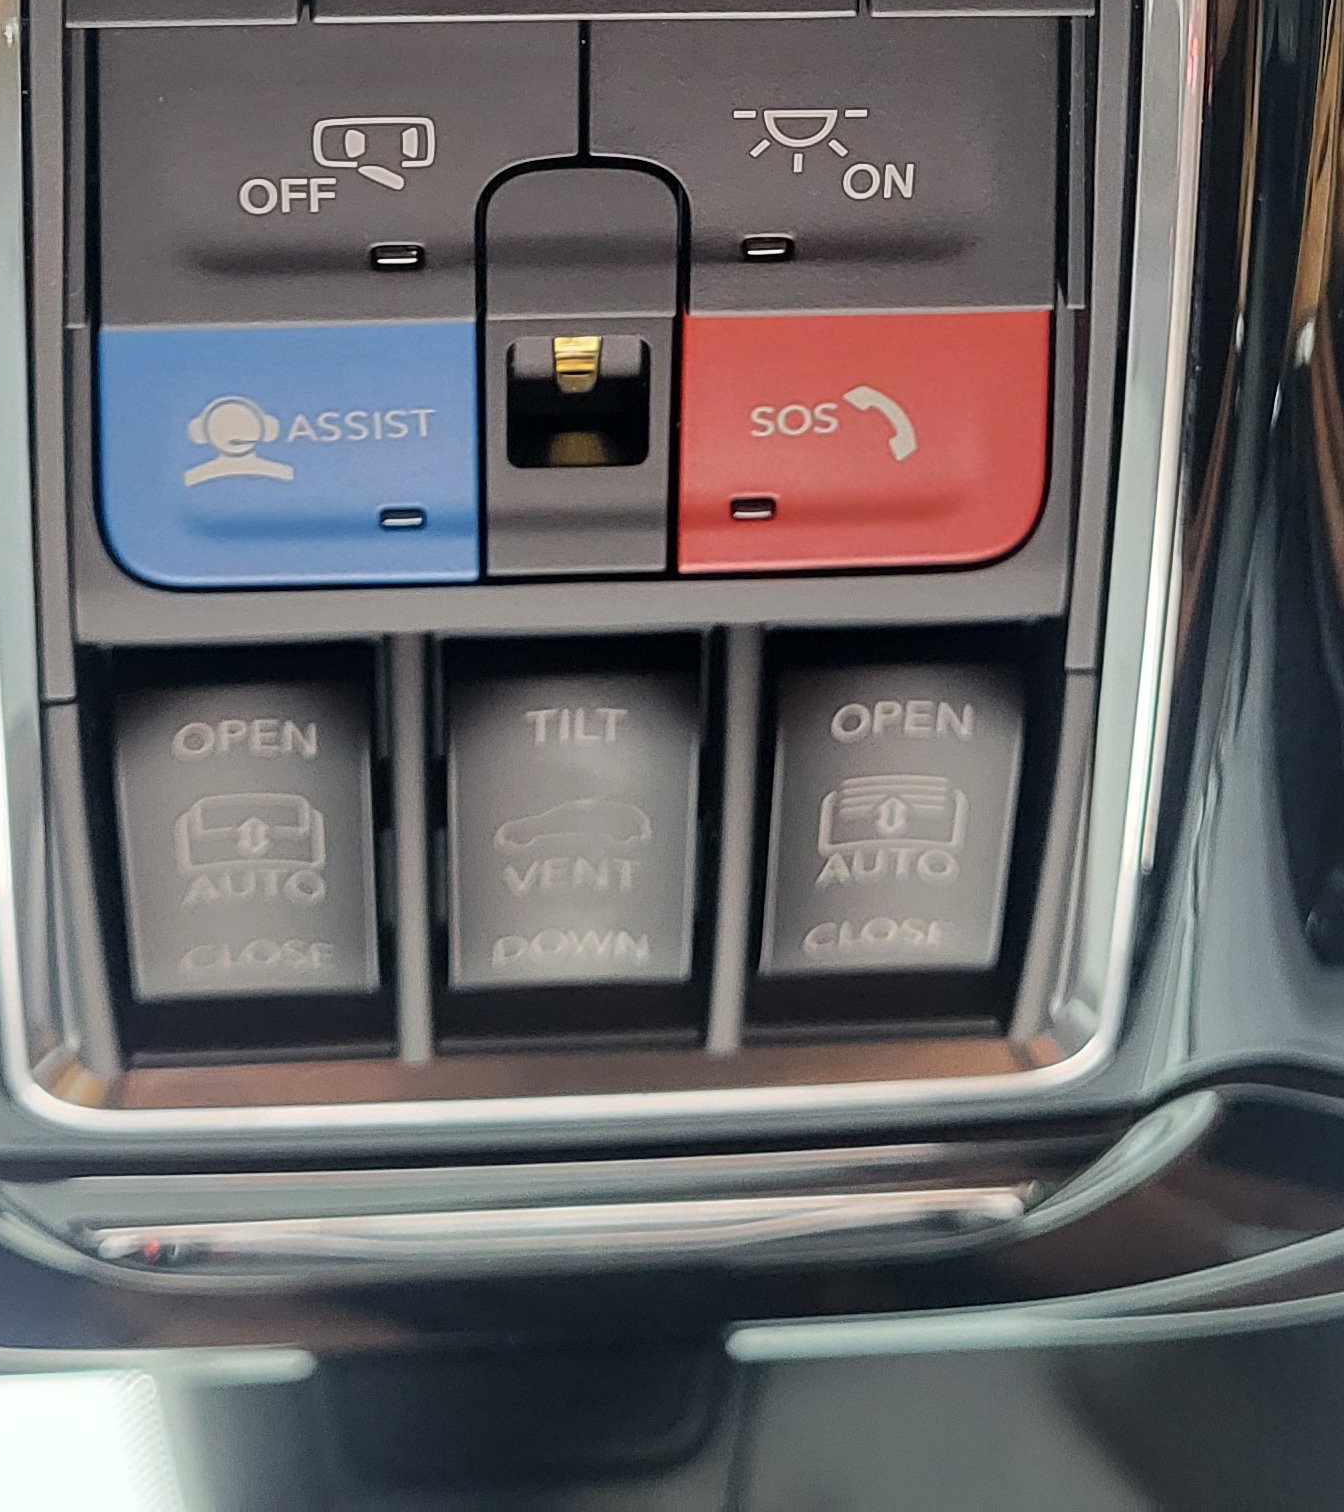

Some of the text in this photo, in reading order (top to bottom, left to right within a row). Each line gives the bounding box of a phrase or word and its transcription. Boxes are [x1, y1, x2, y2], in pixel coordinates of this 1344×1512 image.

[238, 177, 338, 216] OFF
[841, 162, 916, 200] ON
[287, 407, 437, 444] ASSIST
[748, 402, 840, 439] SOS
[171, 719, 318, 761] OPEN
[525, 707, 629, 744] TILT
[830, 699, 976, 743] OPEN
[181, 868, 326, 906] AUTO
[504, 857, 641, 895] VENT
[815, 847, 959, 889] AUTO
[180, 939, 336, 977] CLOSE
[491, 928, 652, 970] DOWN
